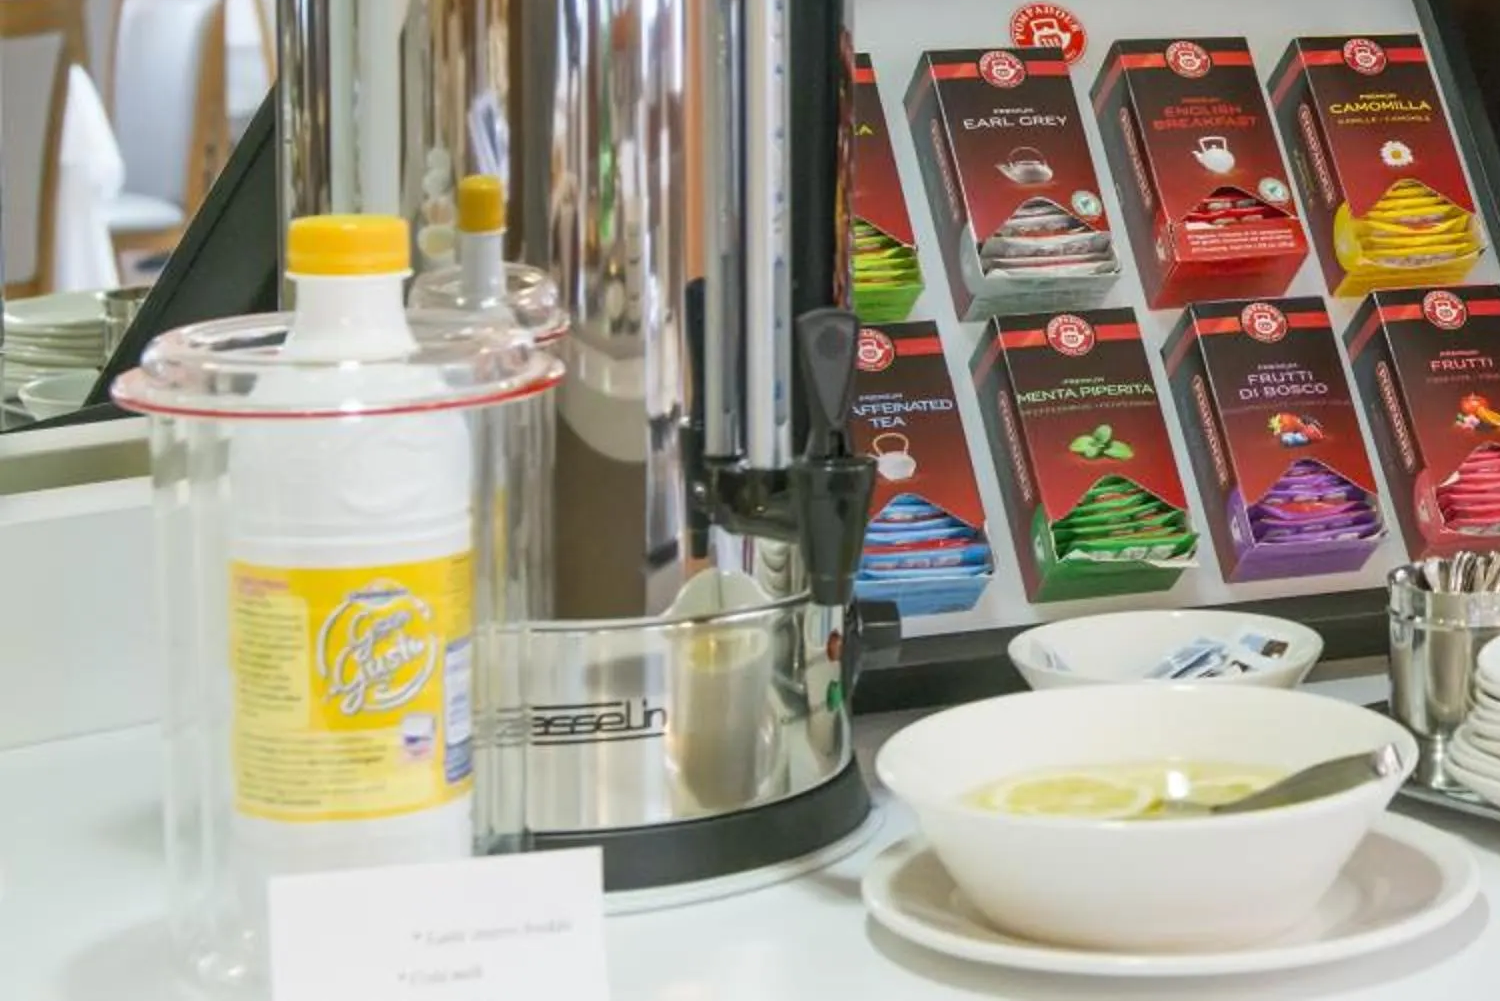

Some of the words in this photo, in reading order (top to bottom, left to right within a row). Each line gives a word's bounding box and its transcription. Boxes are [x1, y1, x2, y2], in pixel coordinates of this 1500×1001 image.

[1329, 100, 1432, 114] CAMOMILLA
[962, 116, 1015, 130] EARL
[1018, 114, 1068, 127] GREY
[1430, 357, 1494, 372] FRUTTI
[1247, 370, 1314, 385] FRUTTI
[1016, 387, 1079, 405] MENTA
[1079, 383, 1155, 398] PIPERITA
[1239, 388, 1259, 400] DI
[1263, 382, 1329, 398] BOSCO
[868, 416, 907, 429] TEA
